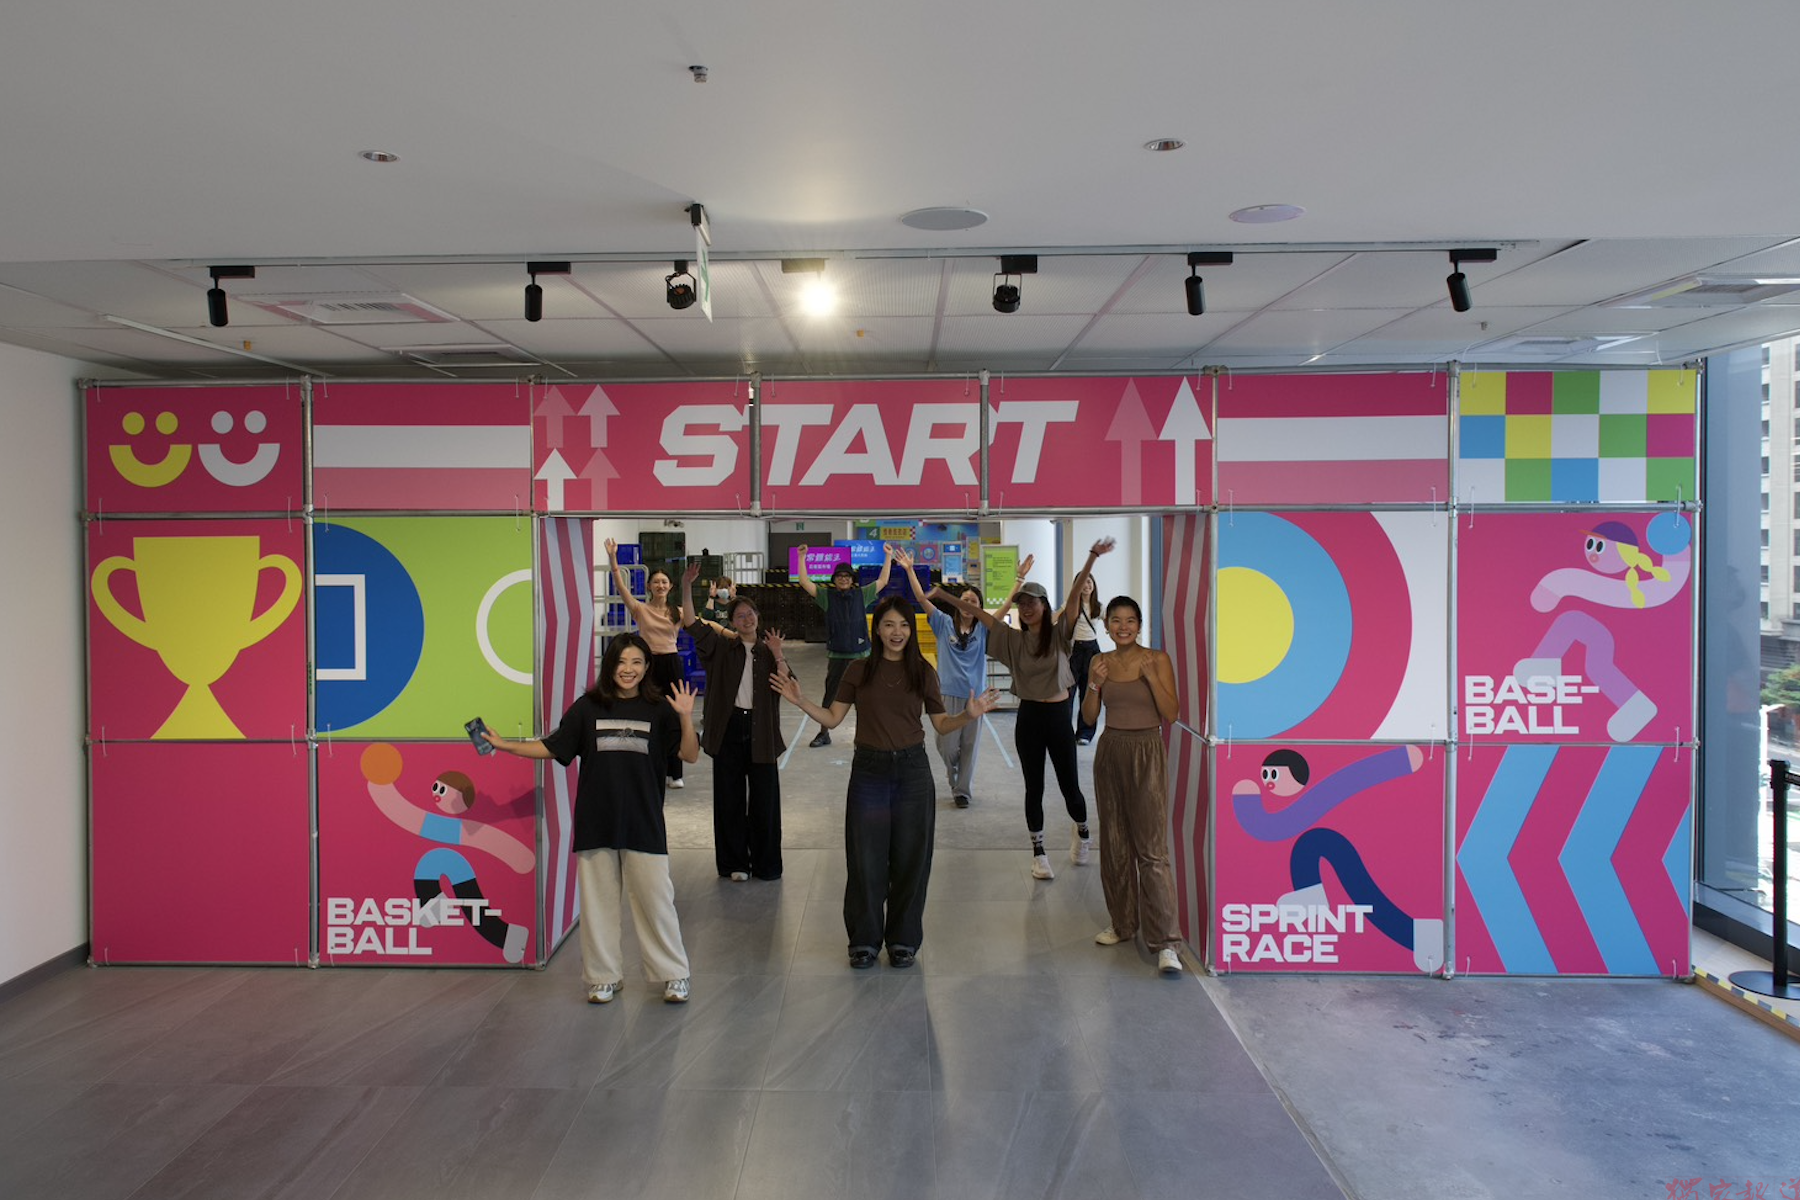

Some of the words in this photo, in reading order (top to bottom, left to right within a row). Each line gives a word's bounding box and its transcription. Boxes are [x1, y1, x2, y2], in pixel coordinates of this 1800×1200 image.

[653, 400, 1079, 486] START
[1465, 675, 1599, 704] BASE-
[1465, 706, 1579, 734] BALL
[327, 898, 502, 926] BASKET-
[1222, 904, 1373, 933] SPRINT
[327, 927, 432, 955] BALL
[1222, 934, 1338, 963] RACE
